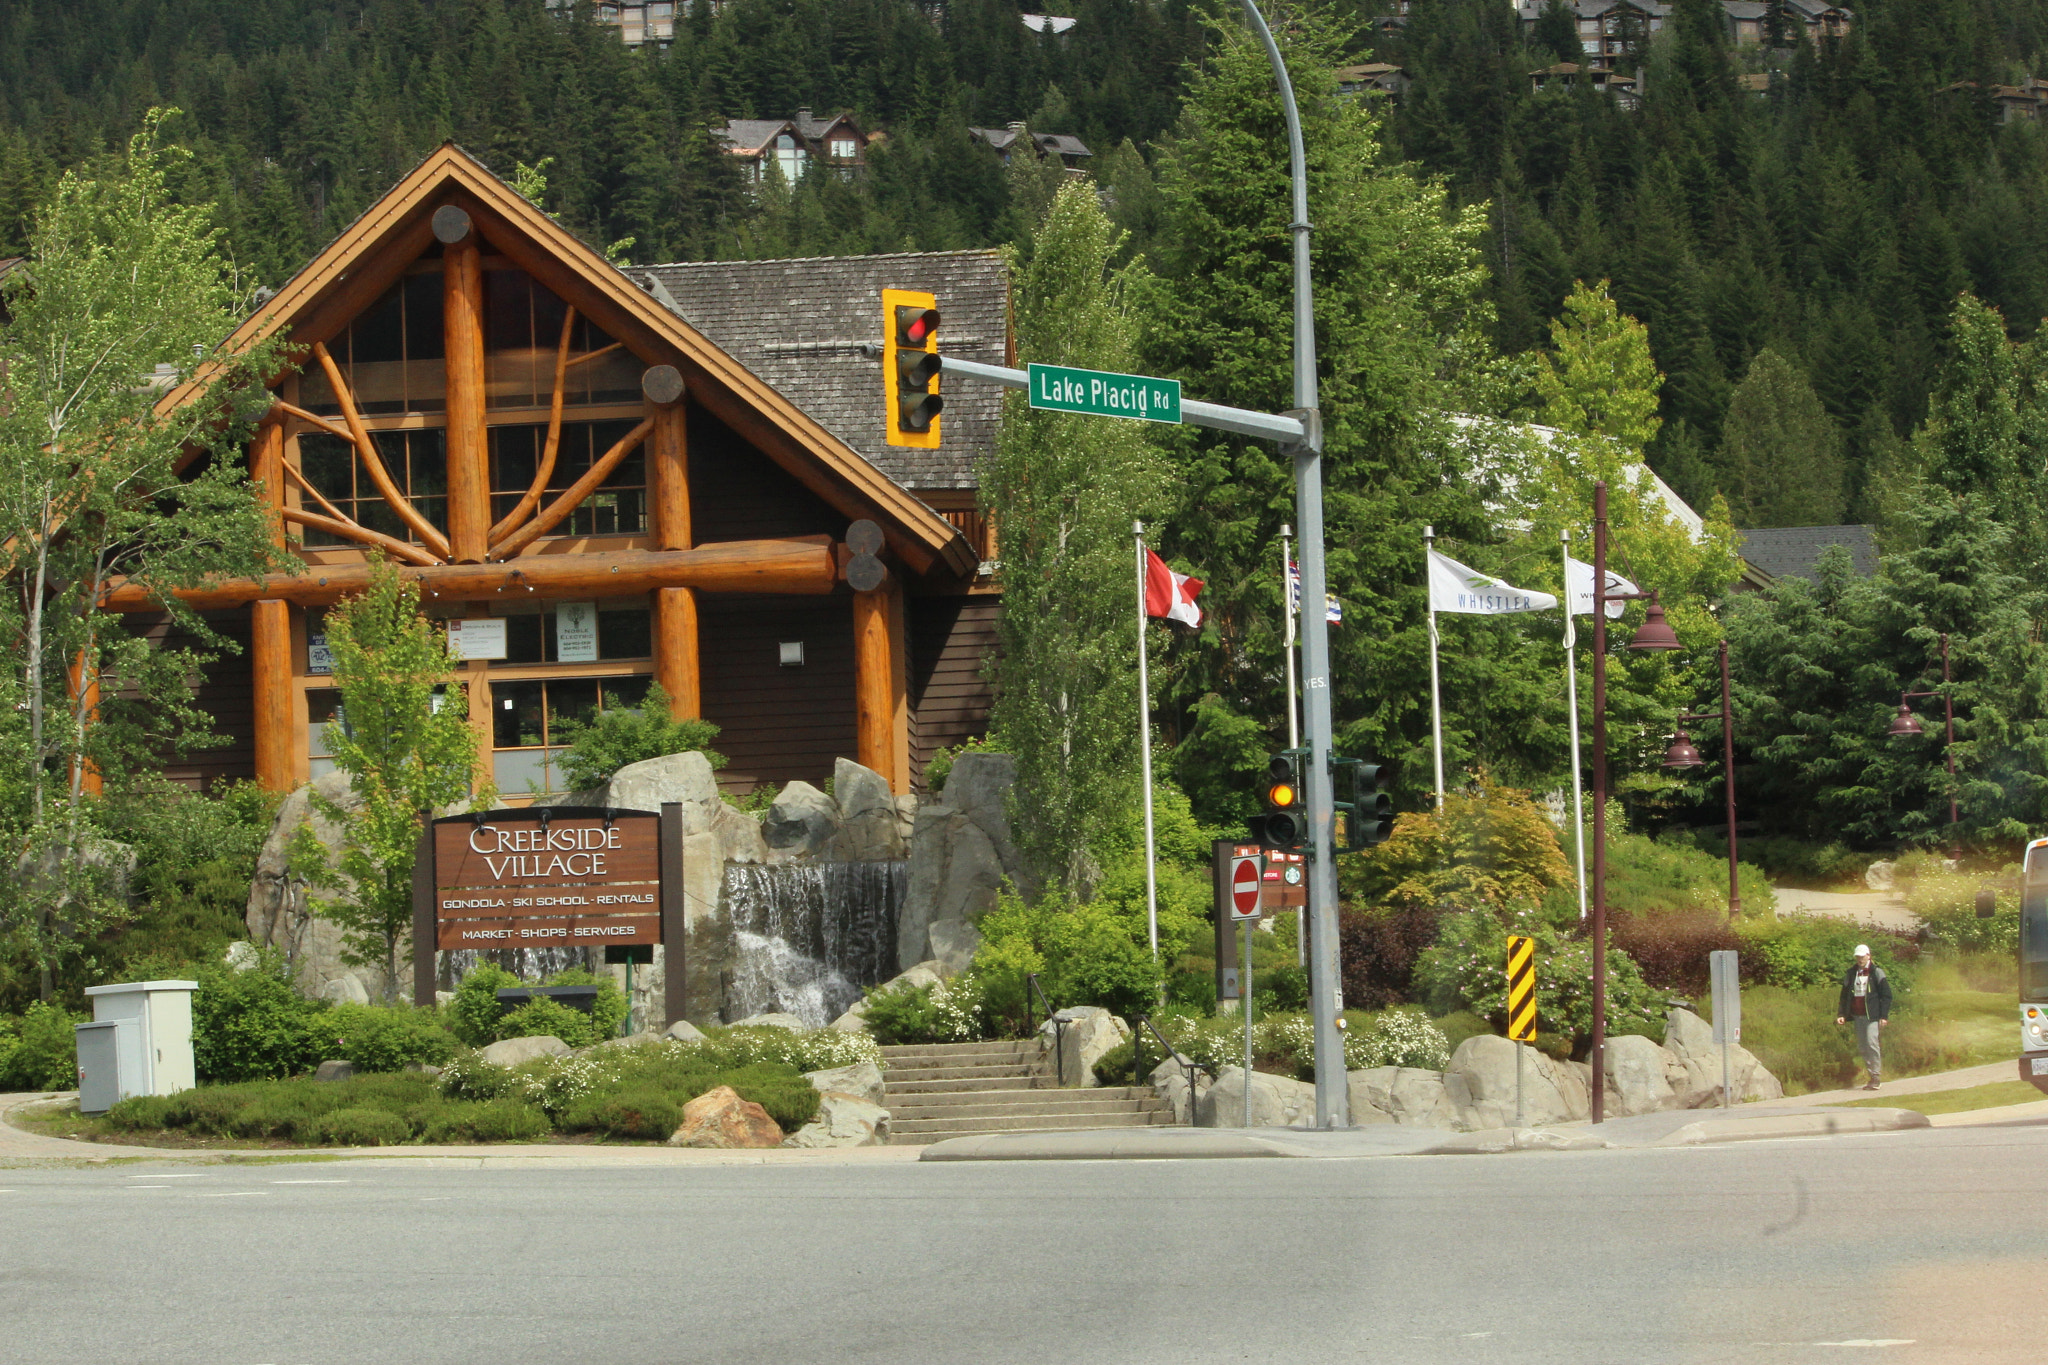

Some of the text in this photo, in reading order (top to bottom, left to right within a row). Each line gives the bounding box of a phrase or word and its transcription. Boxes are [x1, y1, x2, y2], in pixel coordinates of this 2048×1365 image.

[1041, 372, 1169, 411] Lake Placid Rd
[1457, 593, 1531, 611] WHISTLER
[469, 825, 622, 854] CREEKSIDE
[484, 853, 607, 881] VILLAGE
[442, 899, 505, 909] GONDOLA
[513, 897, 532, 907] SKI
[536, 896, 589, 906] SCHOOL
[597, 894, 654, 904] RENTALS
[462, 929, 513, 940] MARKET
[521, 927, 567, 938] SHOPS
[574, 926, 636, 937] SERVICES
